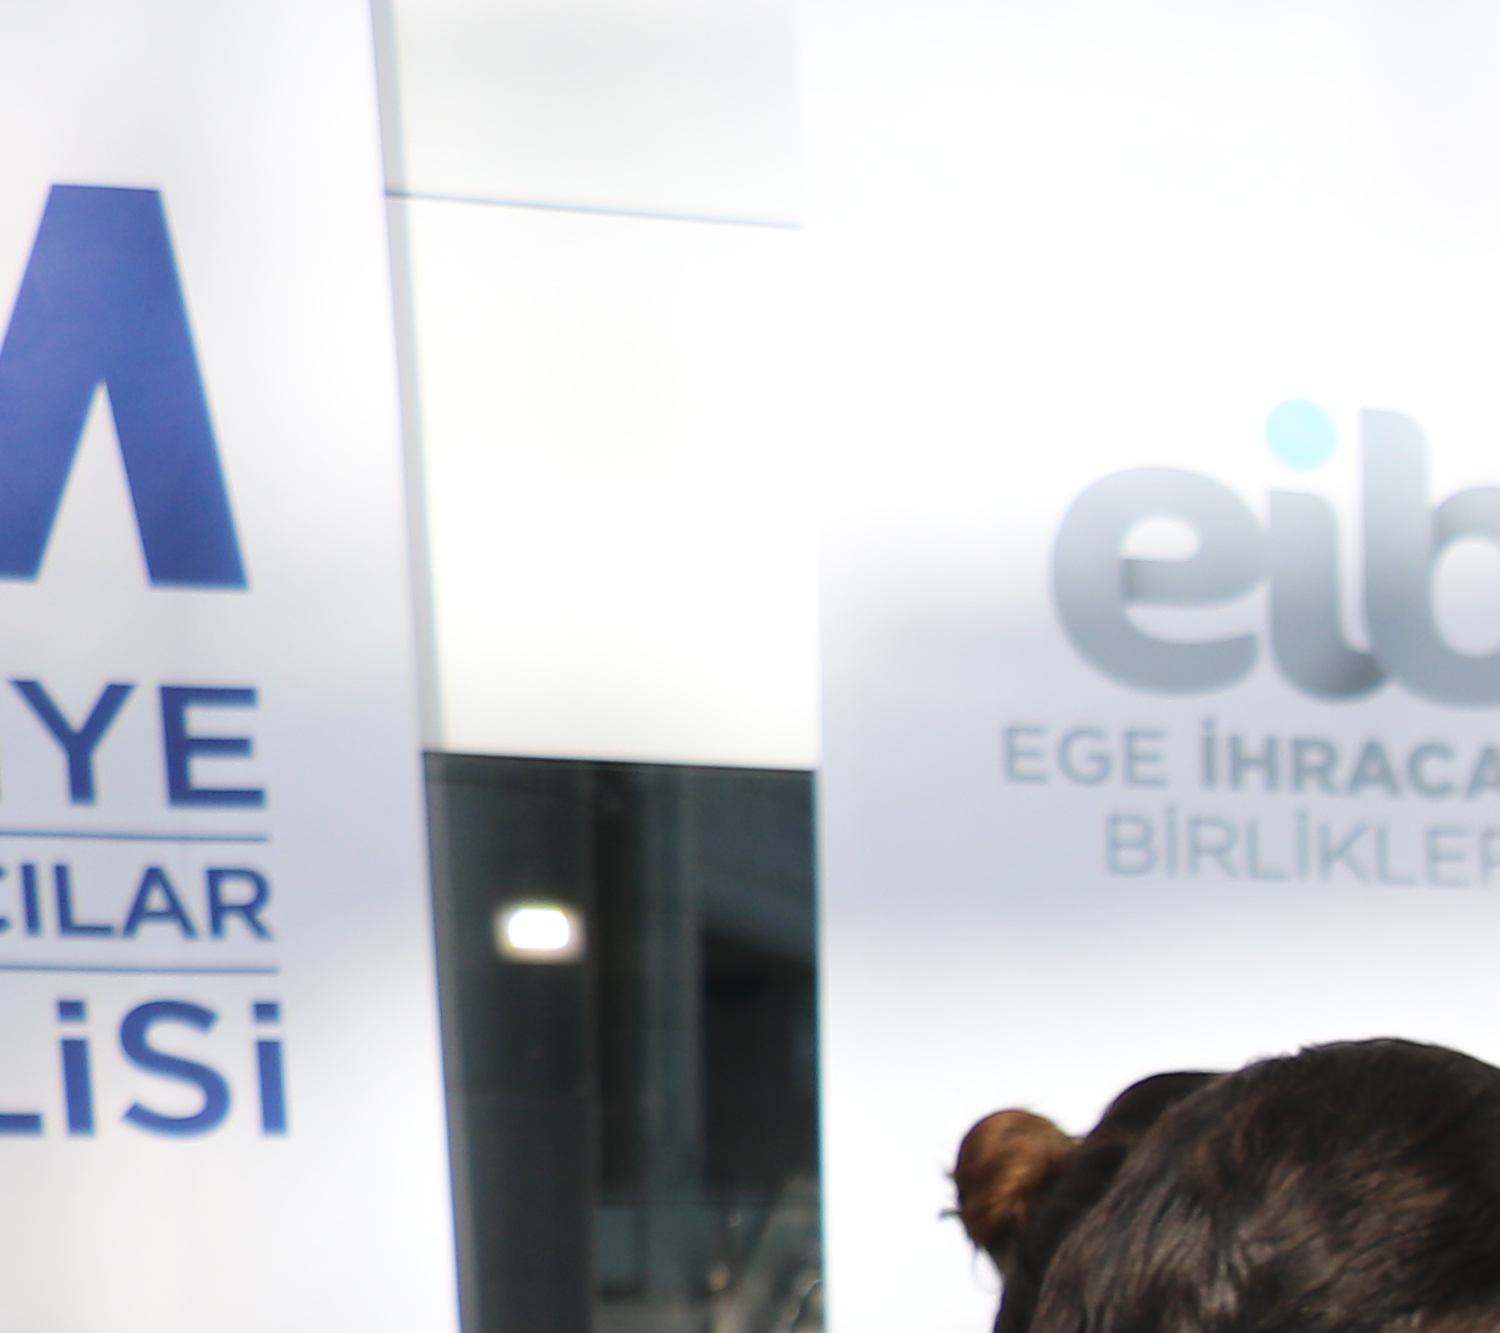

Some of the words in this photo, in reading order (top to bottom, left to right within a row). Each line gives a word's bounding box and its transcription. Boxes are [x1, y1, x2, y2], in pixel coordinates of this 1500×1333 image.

[4, 677, 267, 809] YE
[1003, 724, 1168, 789] EGE
[0, 862, 273, 941] ILAR
